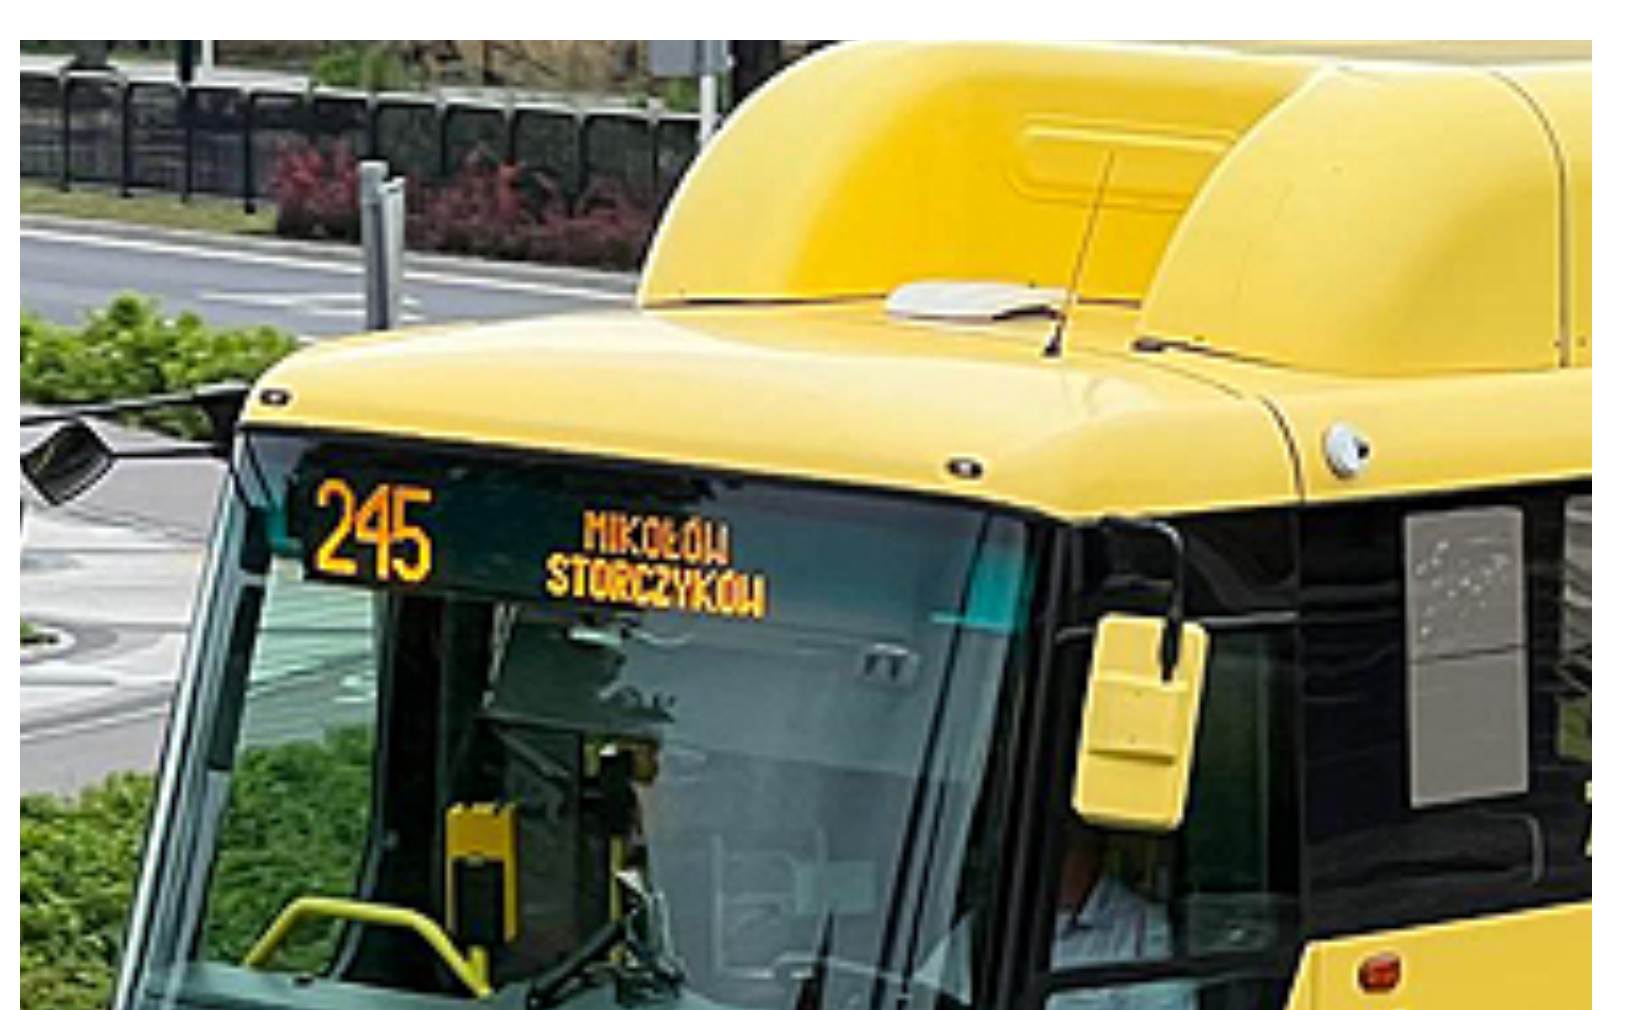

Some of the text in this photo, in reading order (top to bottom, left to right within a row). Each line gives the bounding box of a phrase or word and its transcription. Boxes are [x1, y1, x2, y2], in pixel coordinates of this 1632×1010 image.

[316, 478, 432, 581] 245
[582, 509, 731, 566] MIKOŁÓW
[545, 551, 768, 620] STORCZYKÓW
